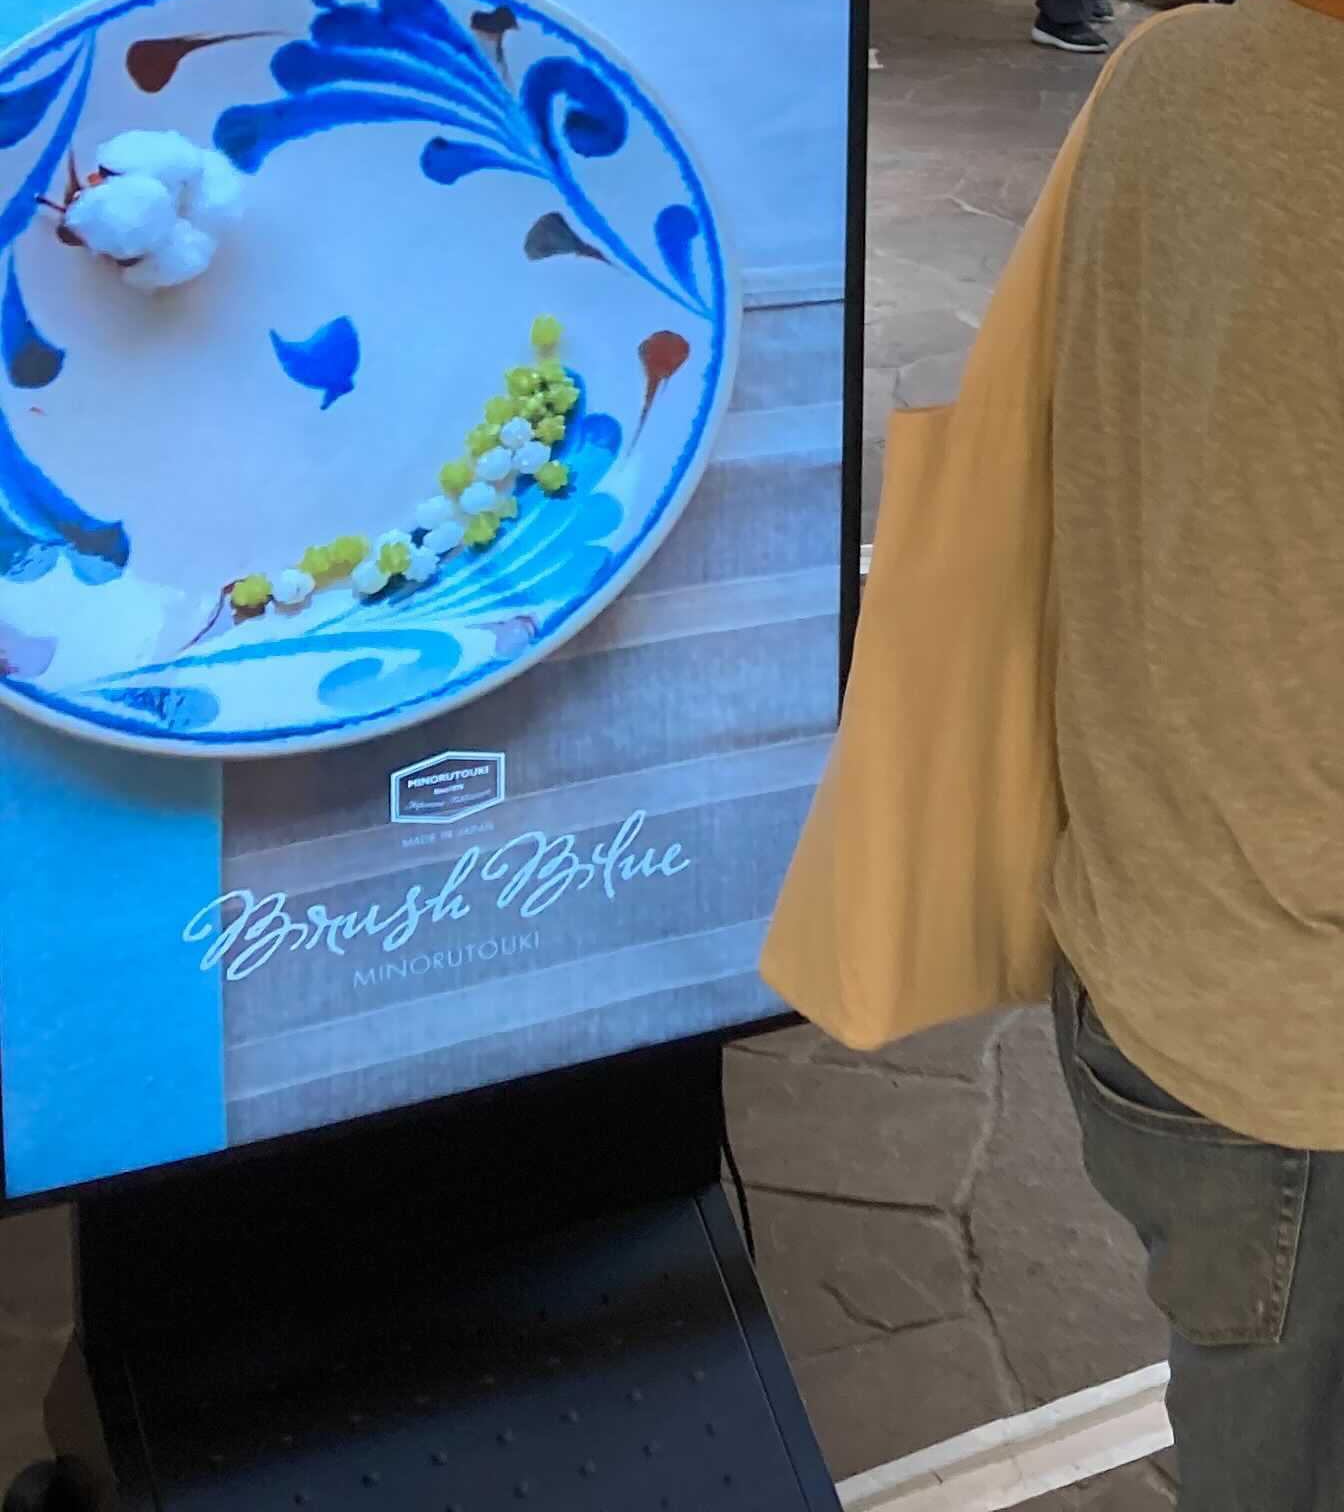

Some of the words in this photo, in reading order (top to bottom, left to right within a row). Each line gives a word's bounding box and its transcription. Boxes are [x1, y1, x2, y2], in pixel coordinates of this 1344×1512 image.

[181, 845, 480, 982] Brush
[480, 808, 693, 918] Blue
[351, 931, 542, 989] MINORUTOUKI
